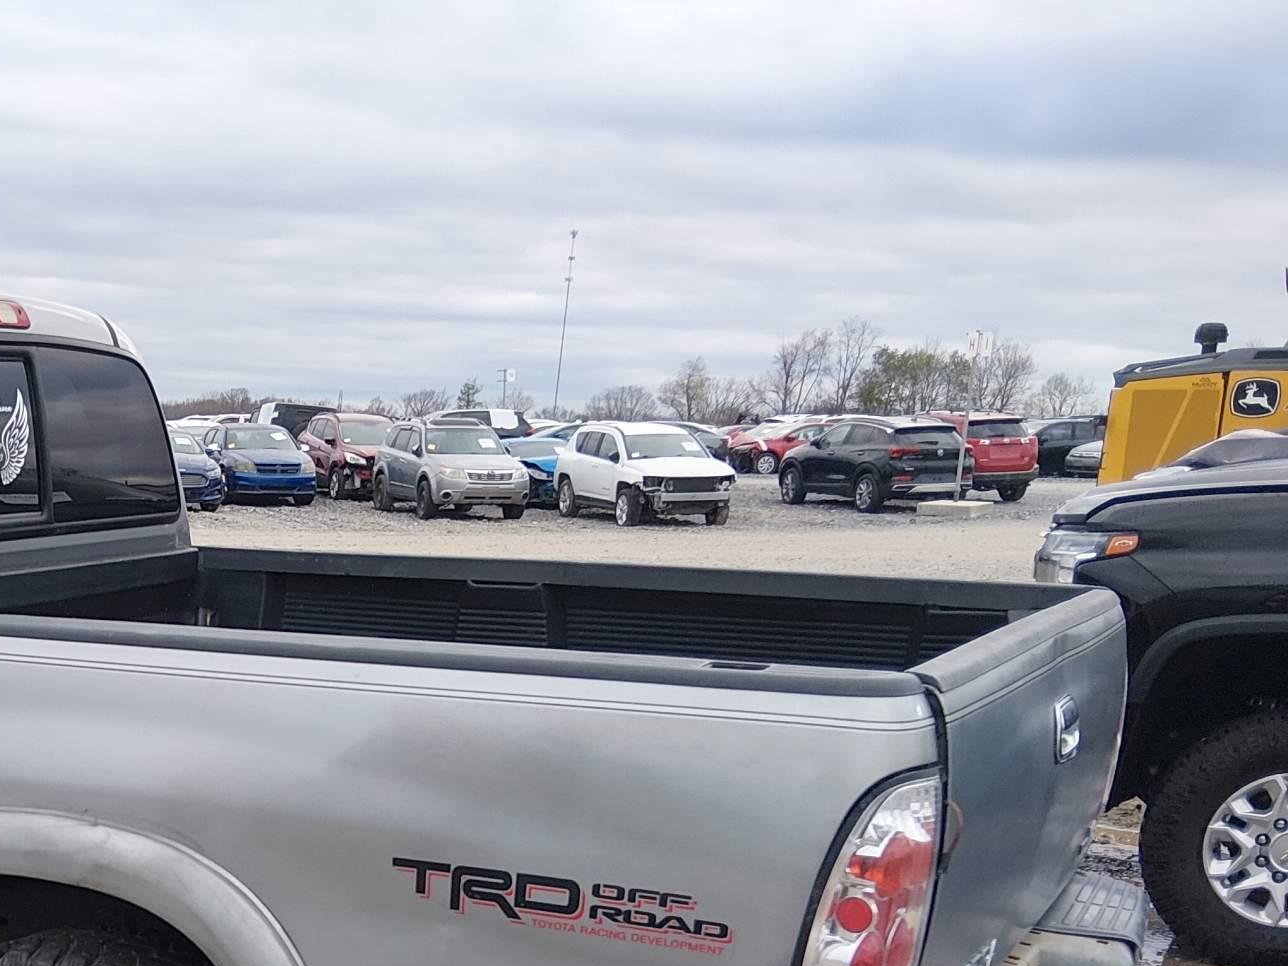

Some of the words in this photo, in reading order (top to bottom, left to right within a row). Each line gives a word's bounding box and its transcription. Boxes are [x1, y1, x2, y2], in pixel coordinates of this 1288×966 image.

[392, 857, 584, 923] TRD
[592, 883, 696, 912] OFF
[531, 918, 577, 934] TOYOTA
[579, 926, 627, 943] RACING
[630, 933, 725, 956] DEVELOPMENT
[589, 904, 733, 943] ROAD
